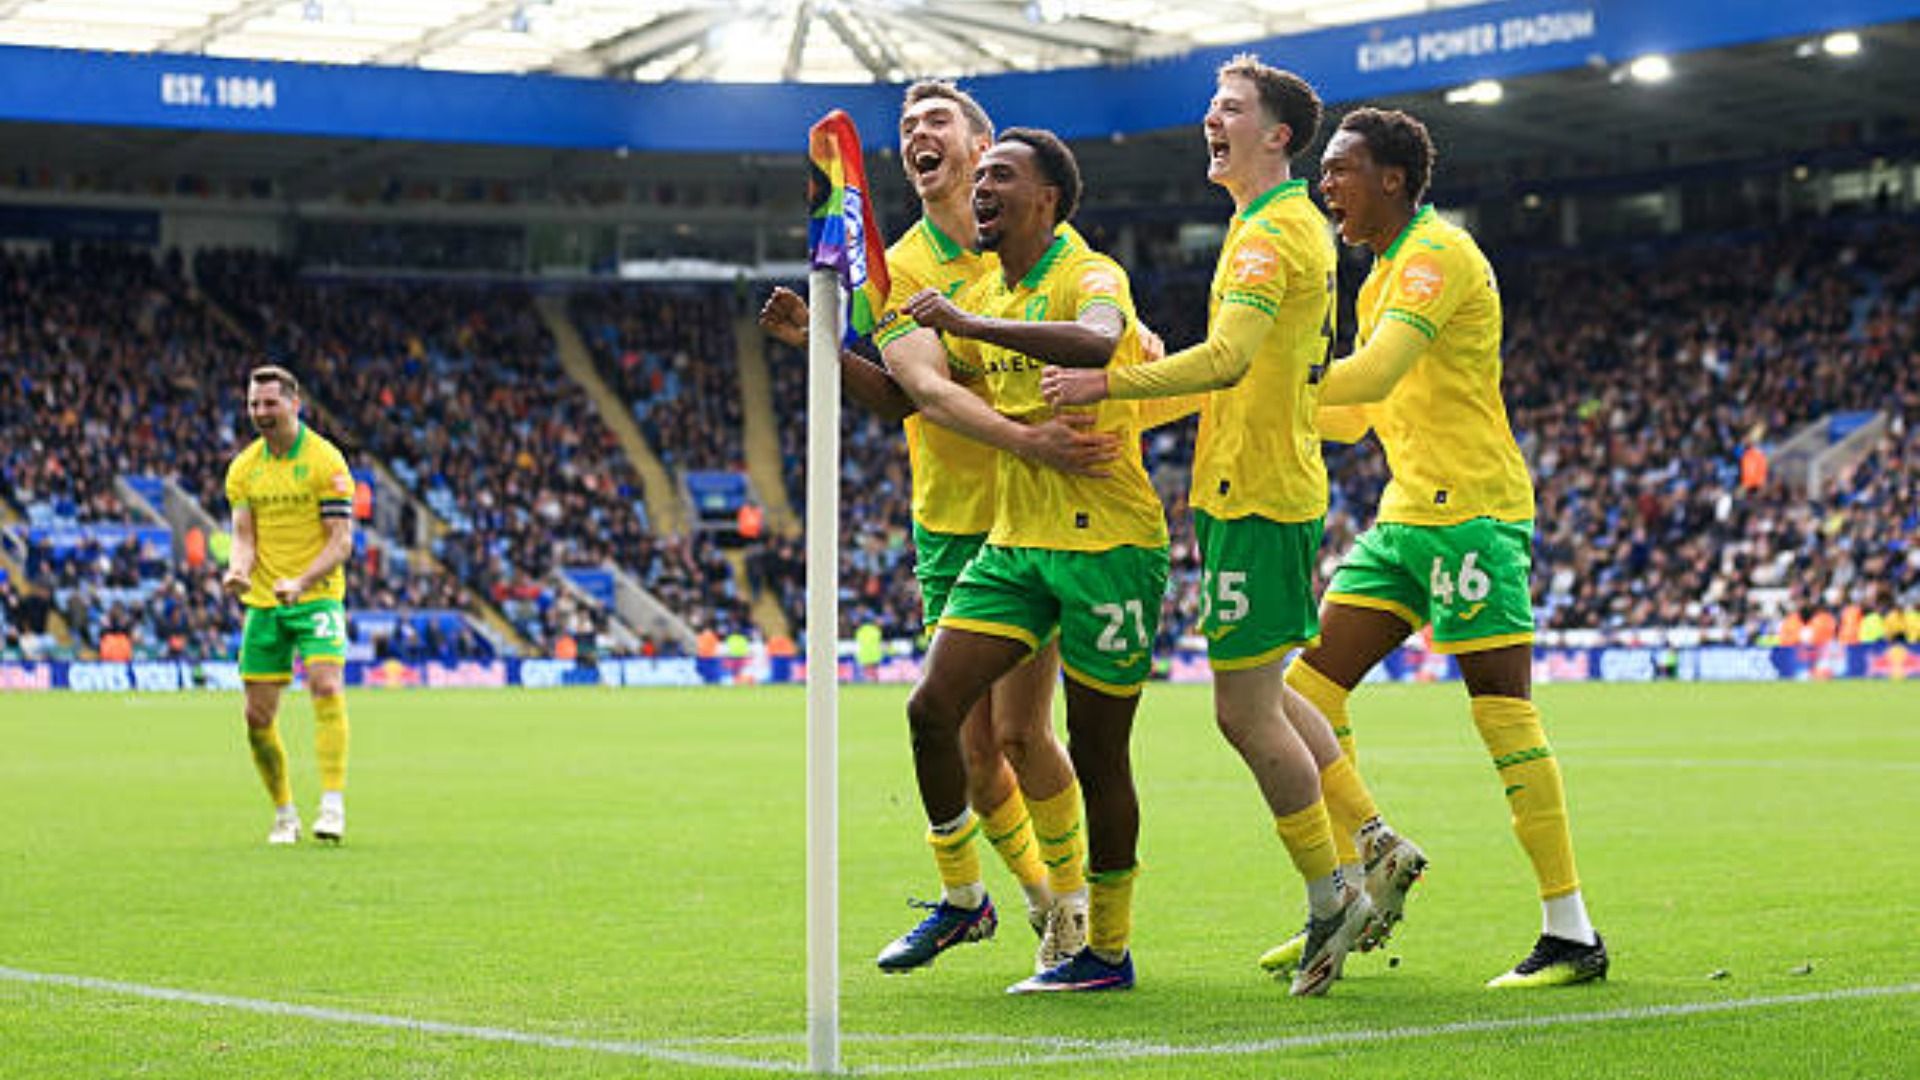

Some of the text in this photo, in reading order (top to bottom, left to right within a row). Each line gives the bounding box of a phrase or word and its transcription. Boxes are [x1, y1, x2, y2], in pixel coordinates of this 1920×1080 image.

[1357, 9, 1594, 73] KING POWER STADIUM
[162, 73, 276, 109] EST. 1884
[1430, 552, 1491, 605] 46
[1092, 600, 1149, 651] 21
